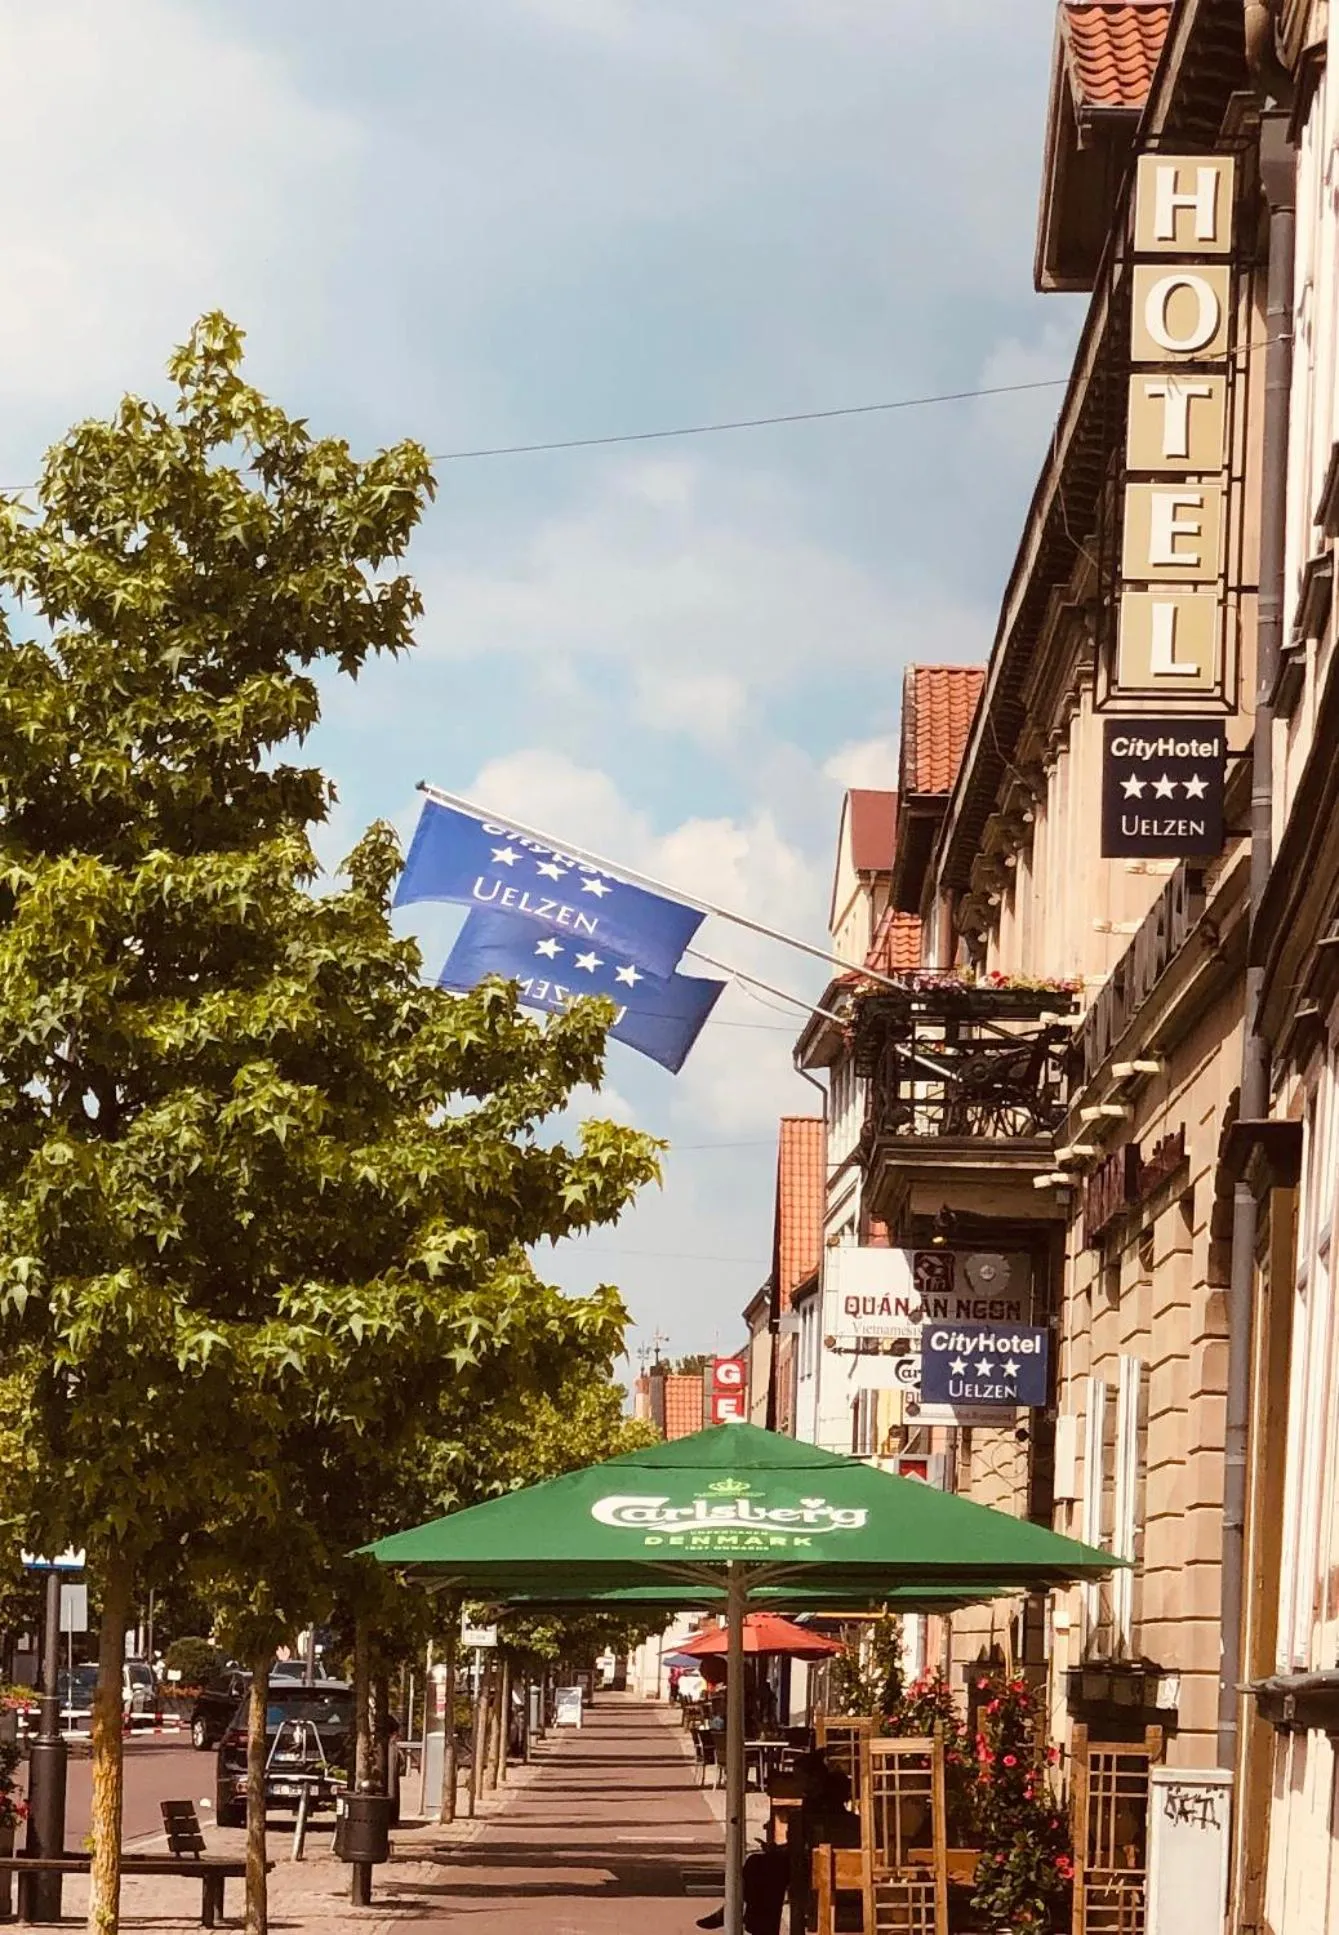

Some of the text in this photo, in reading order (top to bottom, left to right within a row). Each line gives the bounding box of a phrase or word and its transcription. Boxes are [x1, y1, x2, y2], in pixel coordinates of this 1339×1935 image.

[1144, 165, 1220, 678] HOTEL
[1110, 736, 1219, 761] CityHotel
[930, 1331, 1041, 1355] CityHotel
[591, 1494, 869, 1531] Carlsberg
[644, 1535, 813, 1547] DENMARK
